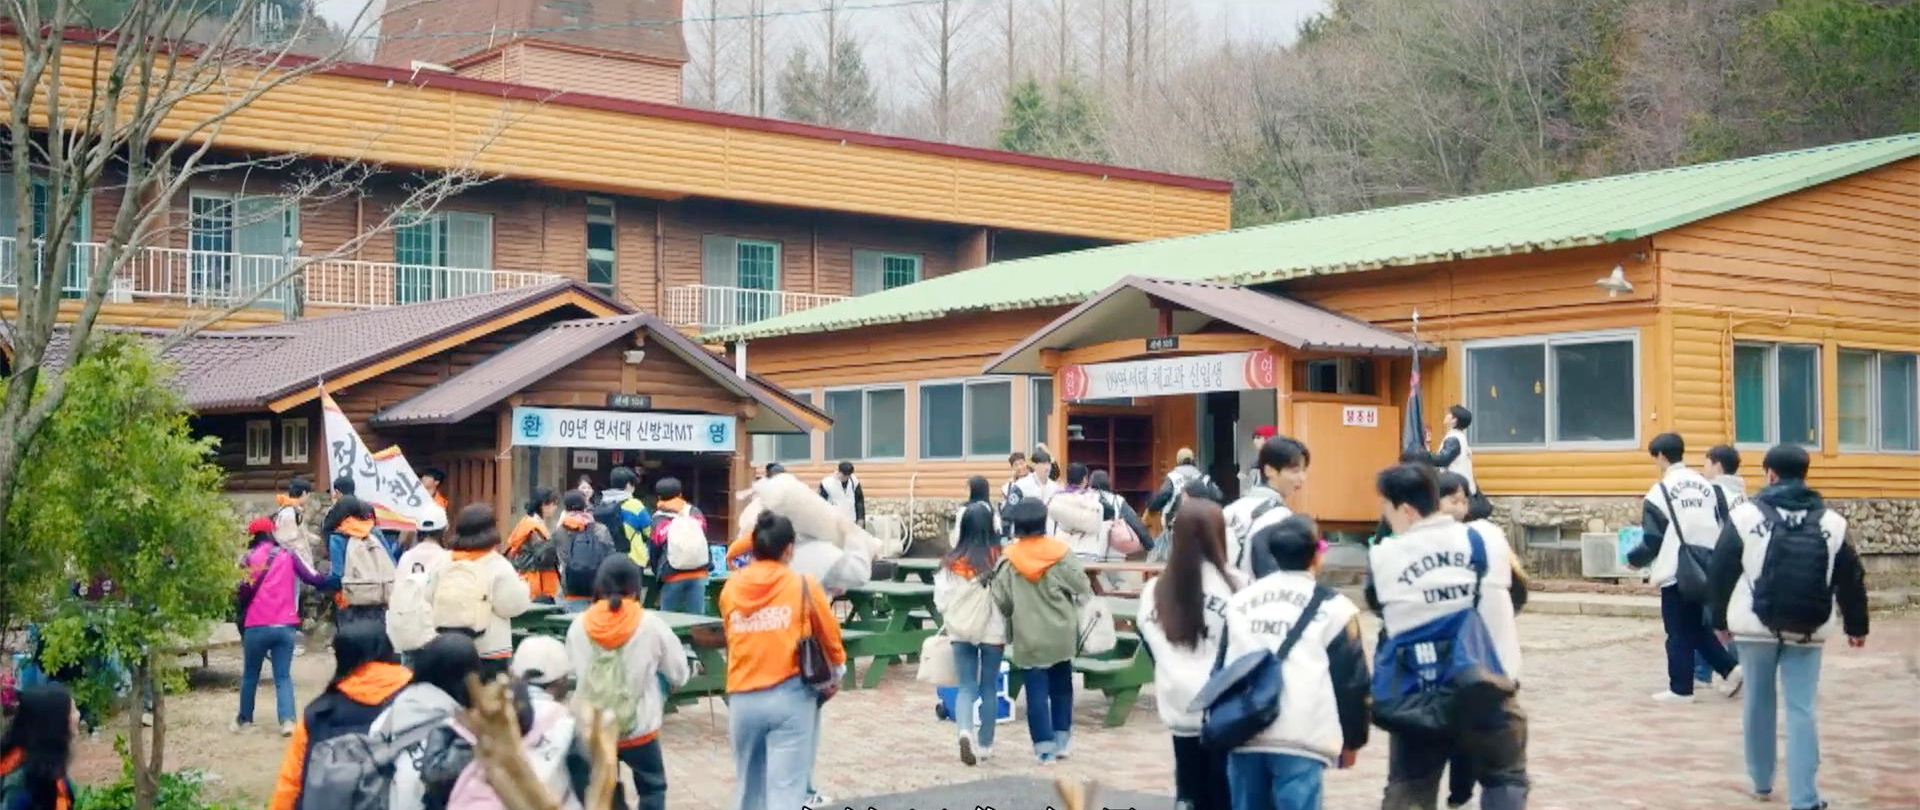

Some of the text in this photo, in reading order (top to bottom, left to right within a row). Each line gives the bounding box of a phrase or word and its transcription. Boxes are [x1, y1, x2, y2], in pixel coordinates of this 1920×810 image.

[1189, 360, 1223, 387] 신입생
[522, 414, 725, 443] 환 09년 연서대 신방과MT 영
[1397, 551, 1479, 586] YEONS
[1423, 583, 1470, 603] UNIV
